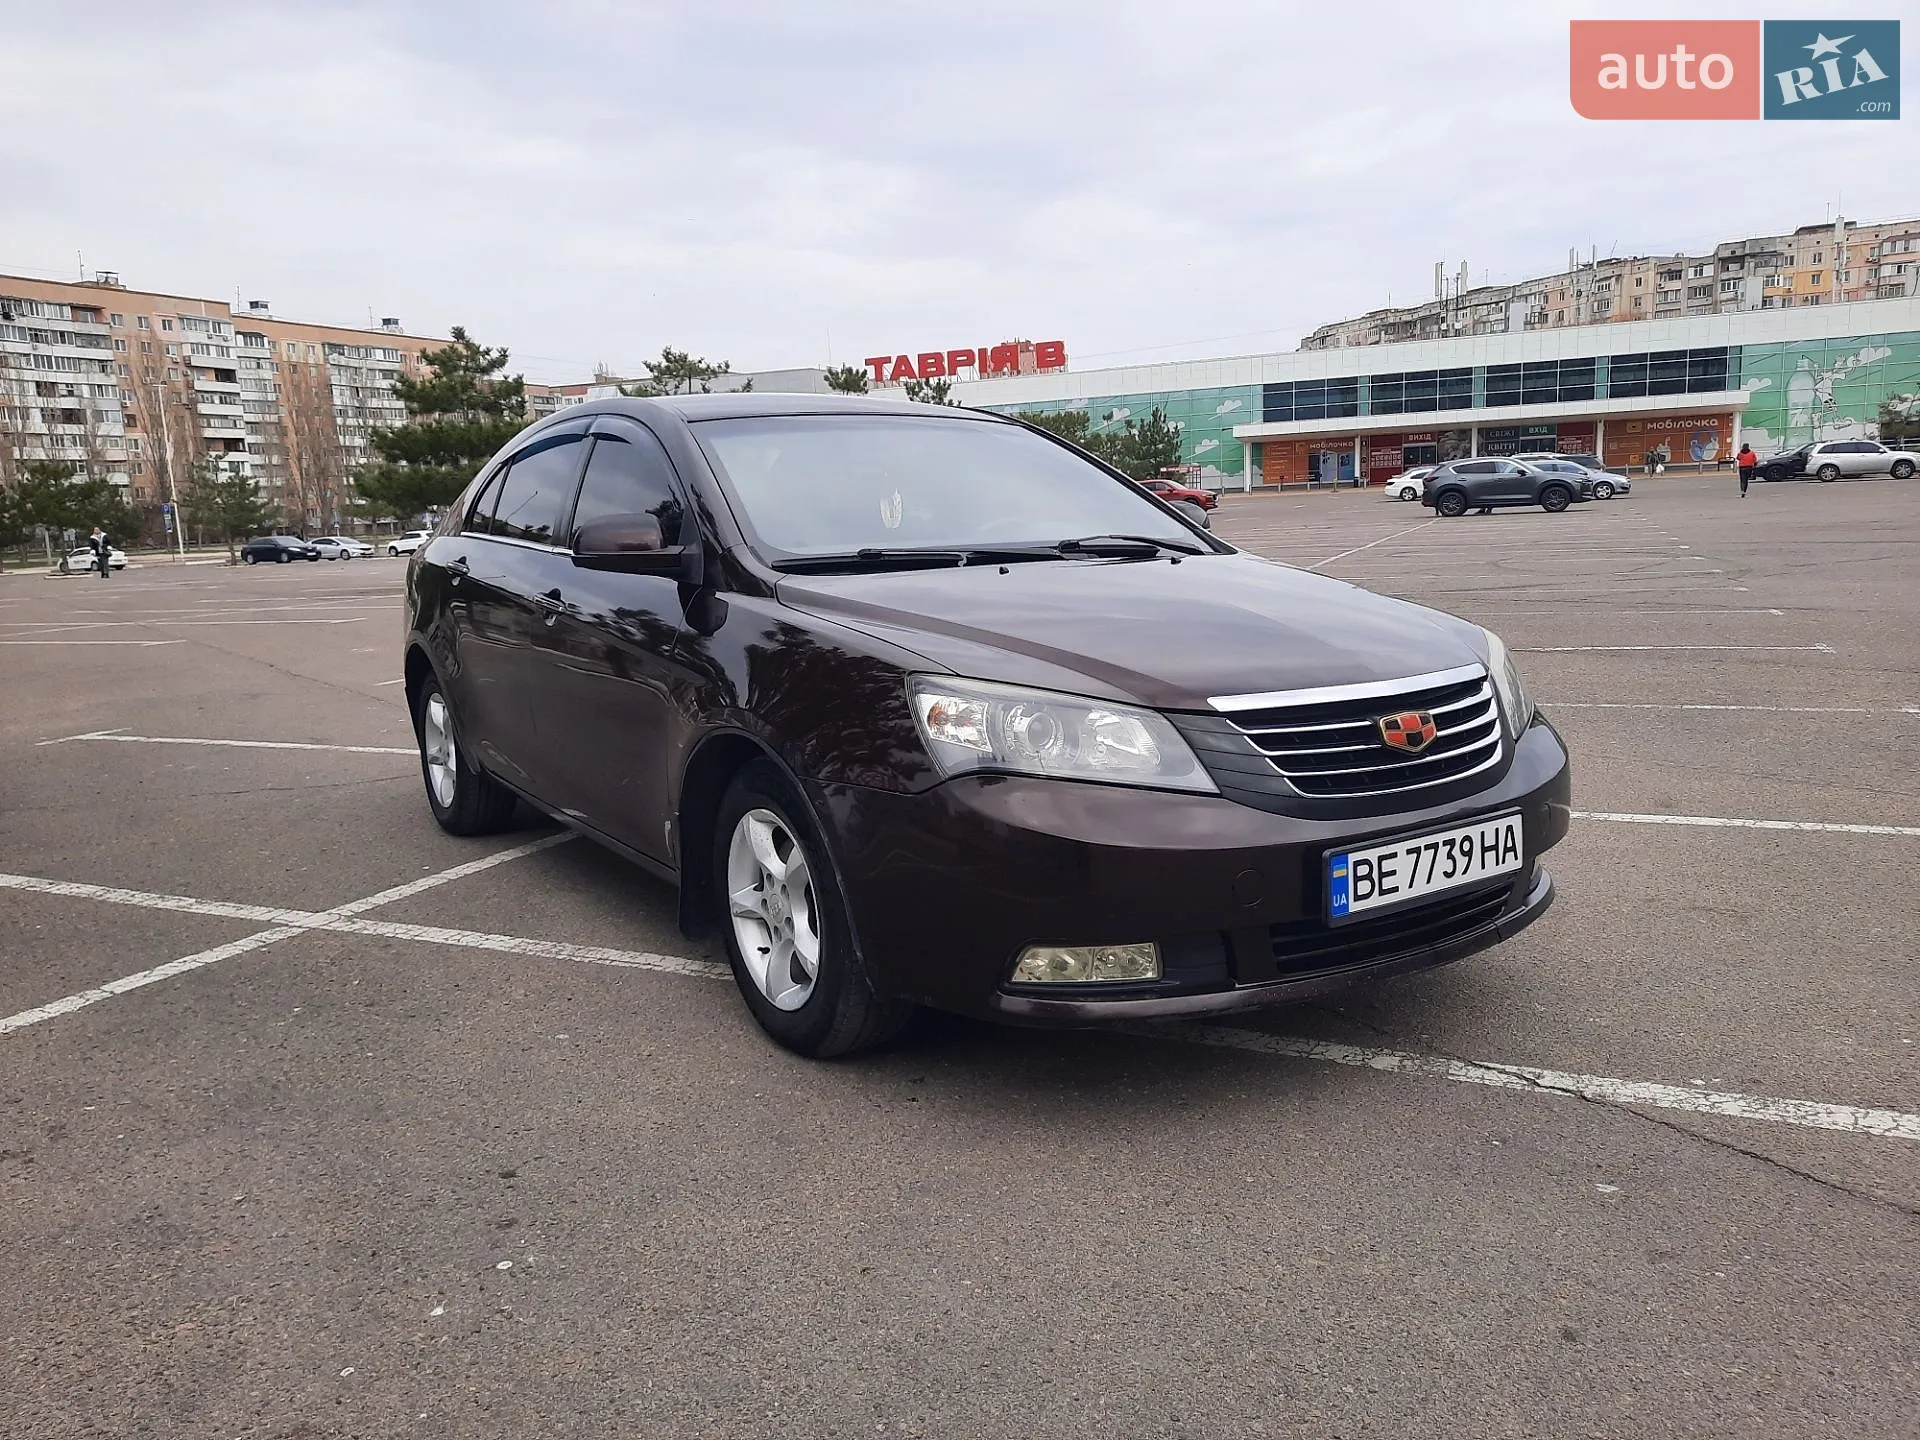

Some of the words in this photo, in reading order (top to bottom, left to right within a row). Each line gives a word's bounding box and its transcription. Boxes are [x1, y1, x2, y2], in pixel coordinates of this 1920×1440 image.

[864, 344, 1019, 382] ТАВРІЯ
[1035, 340, 1066, 369] В
[1352, 851, 1400, 903] BE
[1405, 834, 1474, 889] 7739
[1333, 892, 1348, 907] UA
